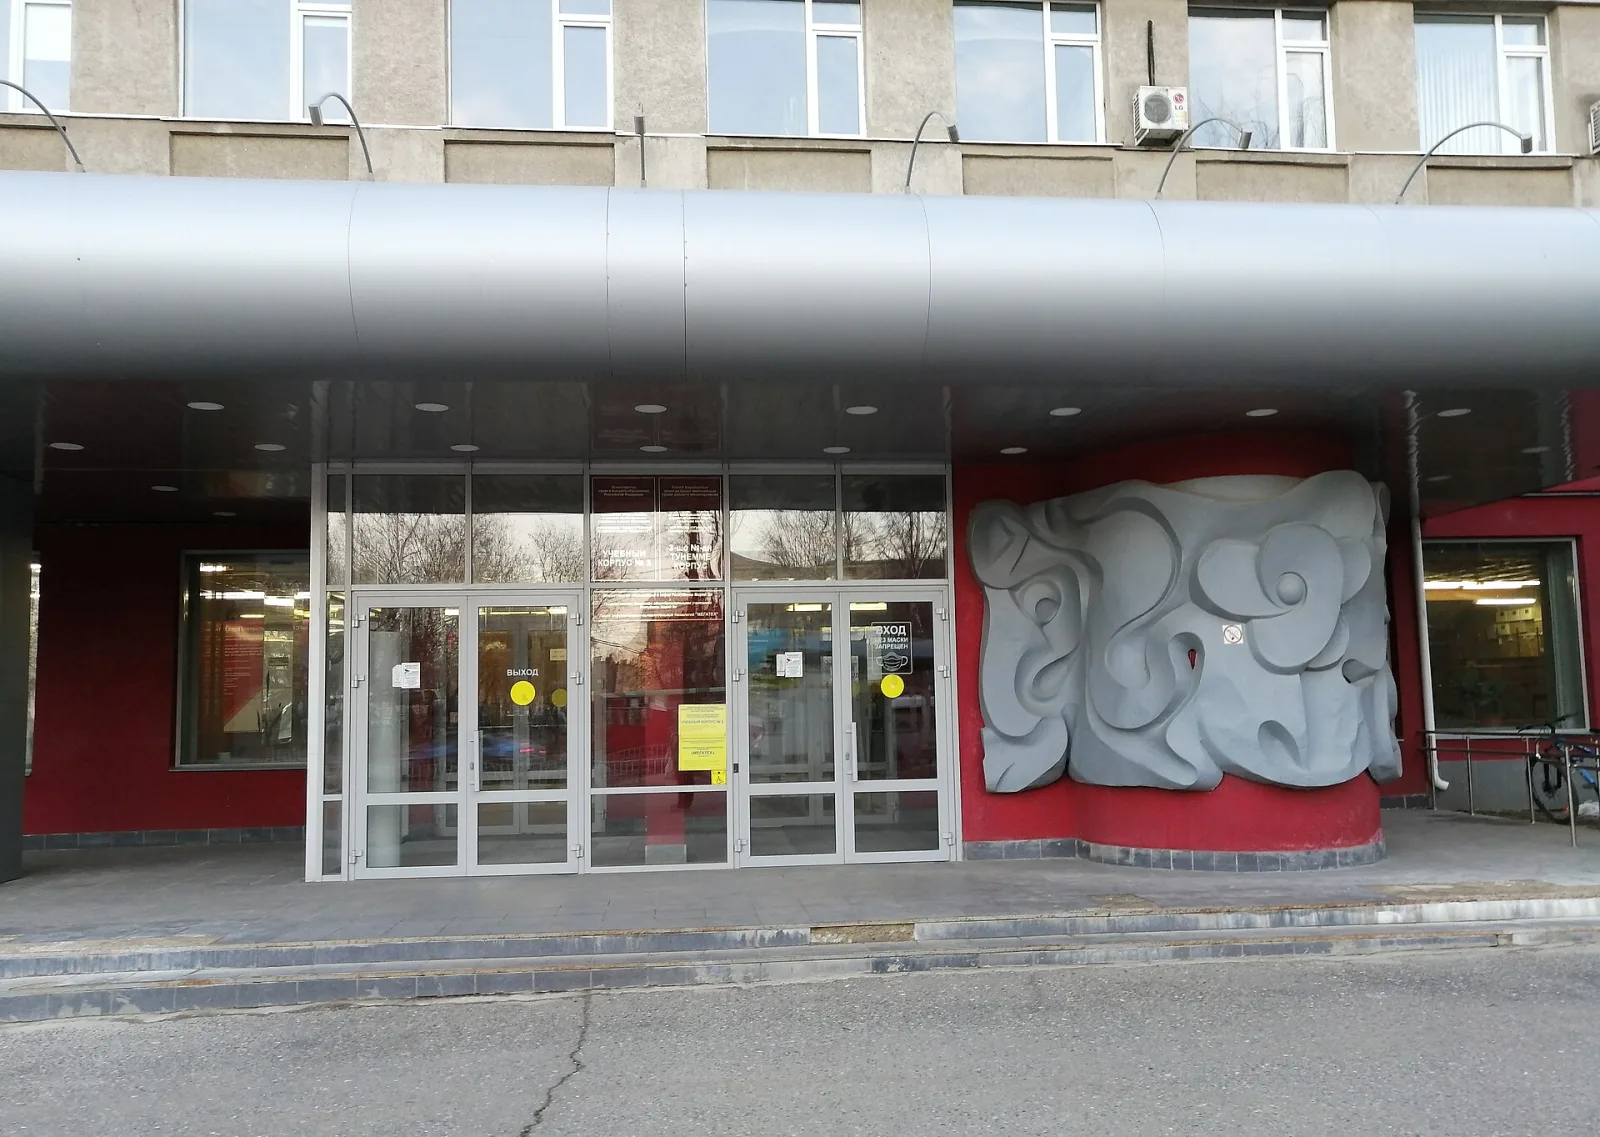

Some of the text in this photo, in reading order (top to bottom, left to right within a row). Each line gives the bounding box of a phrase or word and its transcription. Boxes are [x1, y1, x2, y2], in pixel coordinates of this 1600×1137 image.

[602, 548, 646, 558] УЧЕБНЫЙ
[669, 552, 712, 561] ТУНЕММЕ
[598, 558, 633, 567] КОРПУС
[673, 561, 708, 570] КОРПУС
[876, 625, 906, 636] ВХОД
[506, 668, 539, 677] ВЫХОД
